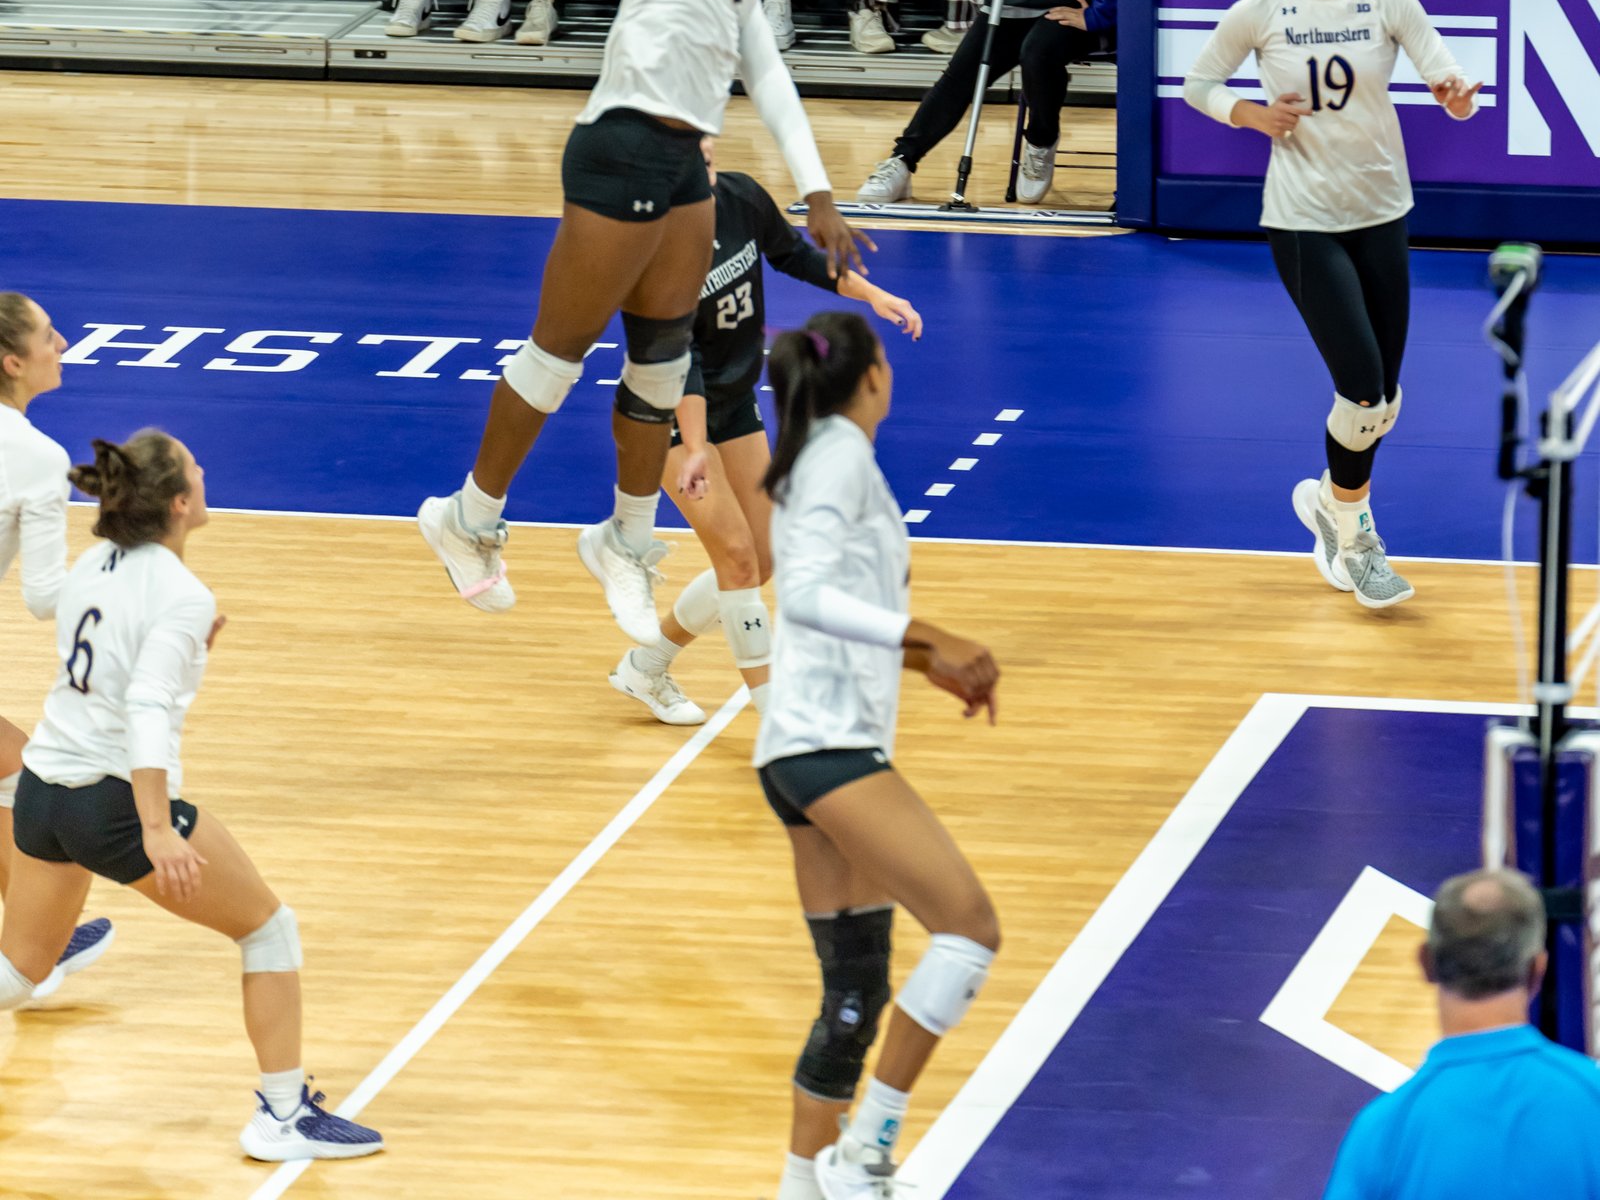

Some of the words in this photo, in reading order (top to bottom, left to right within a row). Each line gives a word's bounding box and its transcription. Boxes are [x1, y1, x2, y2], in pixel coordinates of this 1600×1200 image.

[1285, 27, 1371, 45] Northwestern
[1306, 54, 1355, 111] 19
[716, 281, 755, 330] 23
[66, 607, 102, 695] 6
